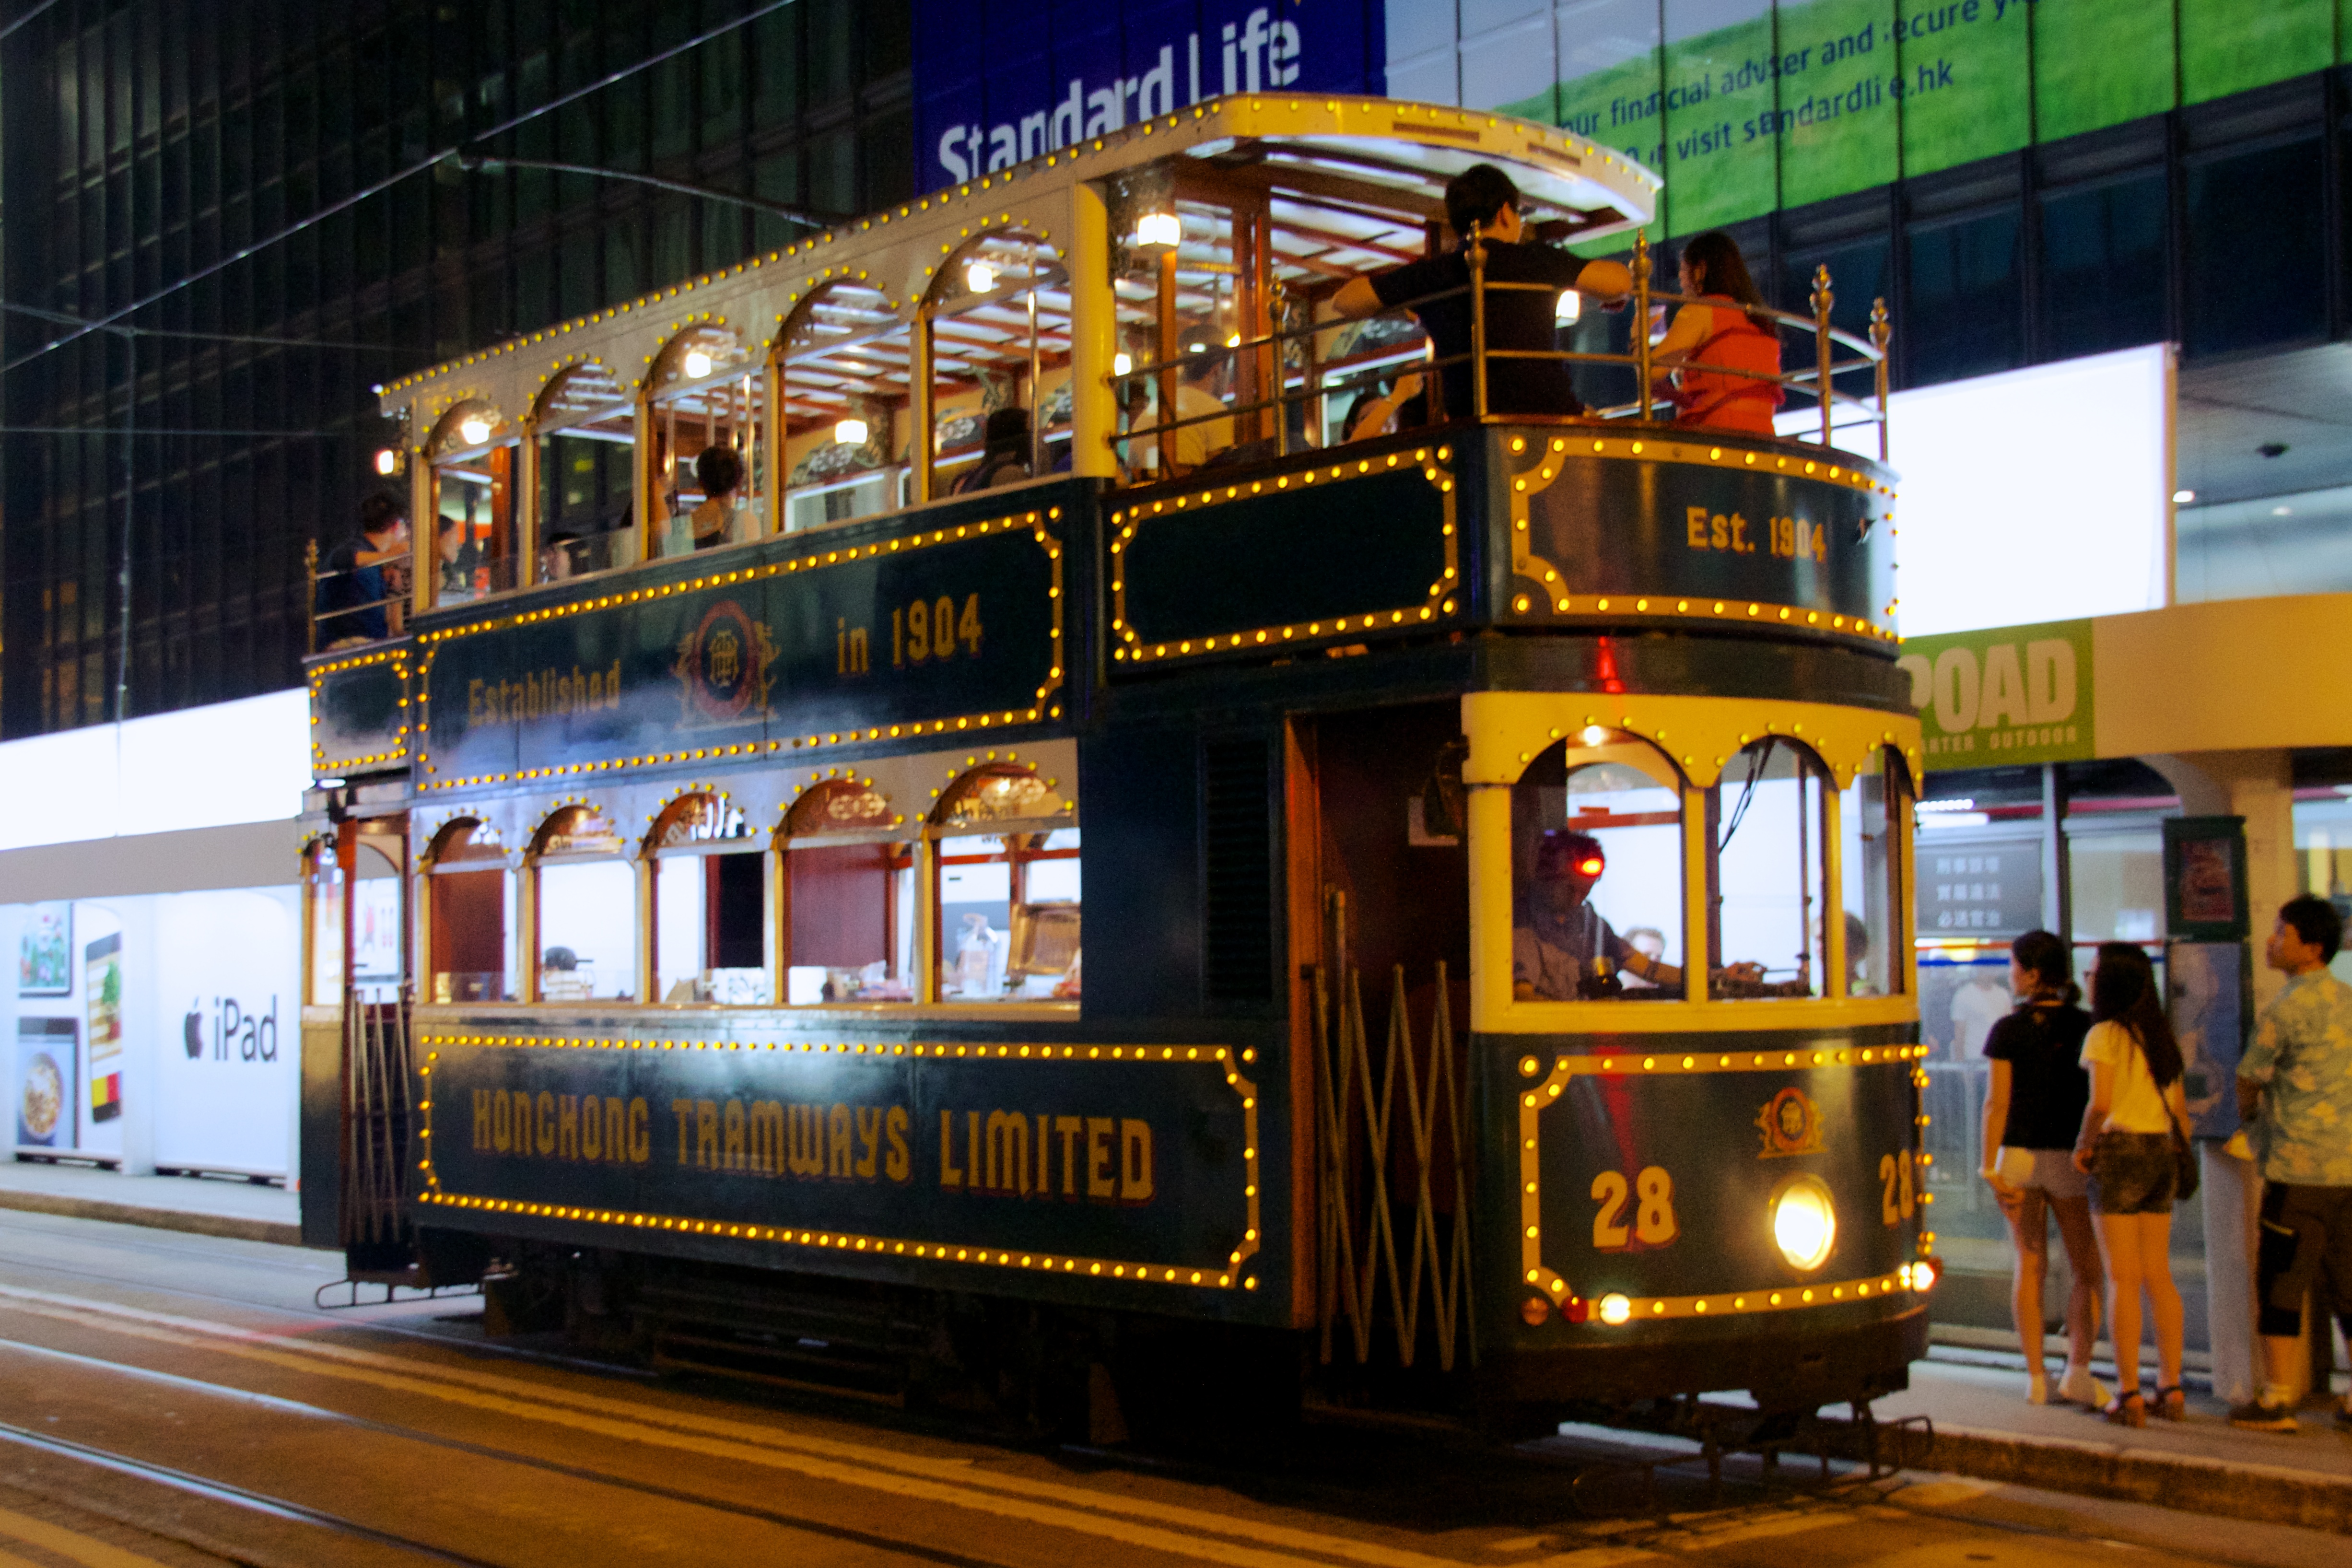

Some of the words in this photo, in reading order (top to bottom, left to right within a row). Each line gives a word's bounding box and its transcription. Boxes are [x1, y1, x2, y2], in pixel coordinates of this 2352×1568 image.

[939, 46, 1173, 185] Standard
[1188, 7, 1301, 105] Life
[1610, 73, 1711, 128] finacial
[1822, 23, 1873, 65] and
[1884, 0, 1979, 43] ecure
[1676, 122, 1732, 160] visit
[1687, 506, 1755, 553] Est.
[1769, 516, 1826, 563] 1904
[468, 658, 620, 727] Established
[838, 617, 869, 673] in
[892, 593, 983, 667] 1904
[215, 994, 277, 1062] iPad
[672, 1099, 909, 1182] TRAMWAYS
[940, 1109, 1155, 1200] LIMITED
[1879, 1149, 1915, 1228] 28
[1591, 1166, 1677, 1251] 28
